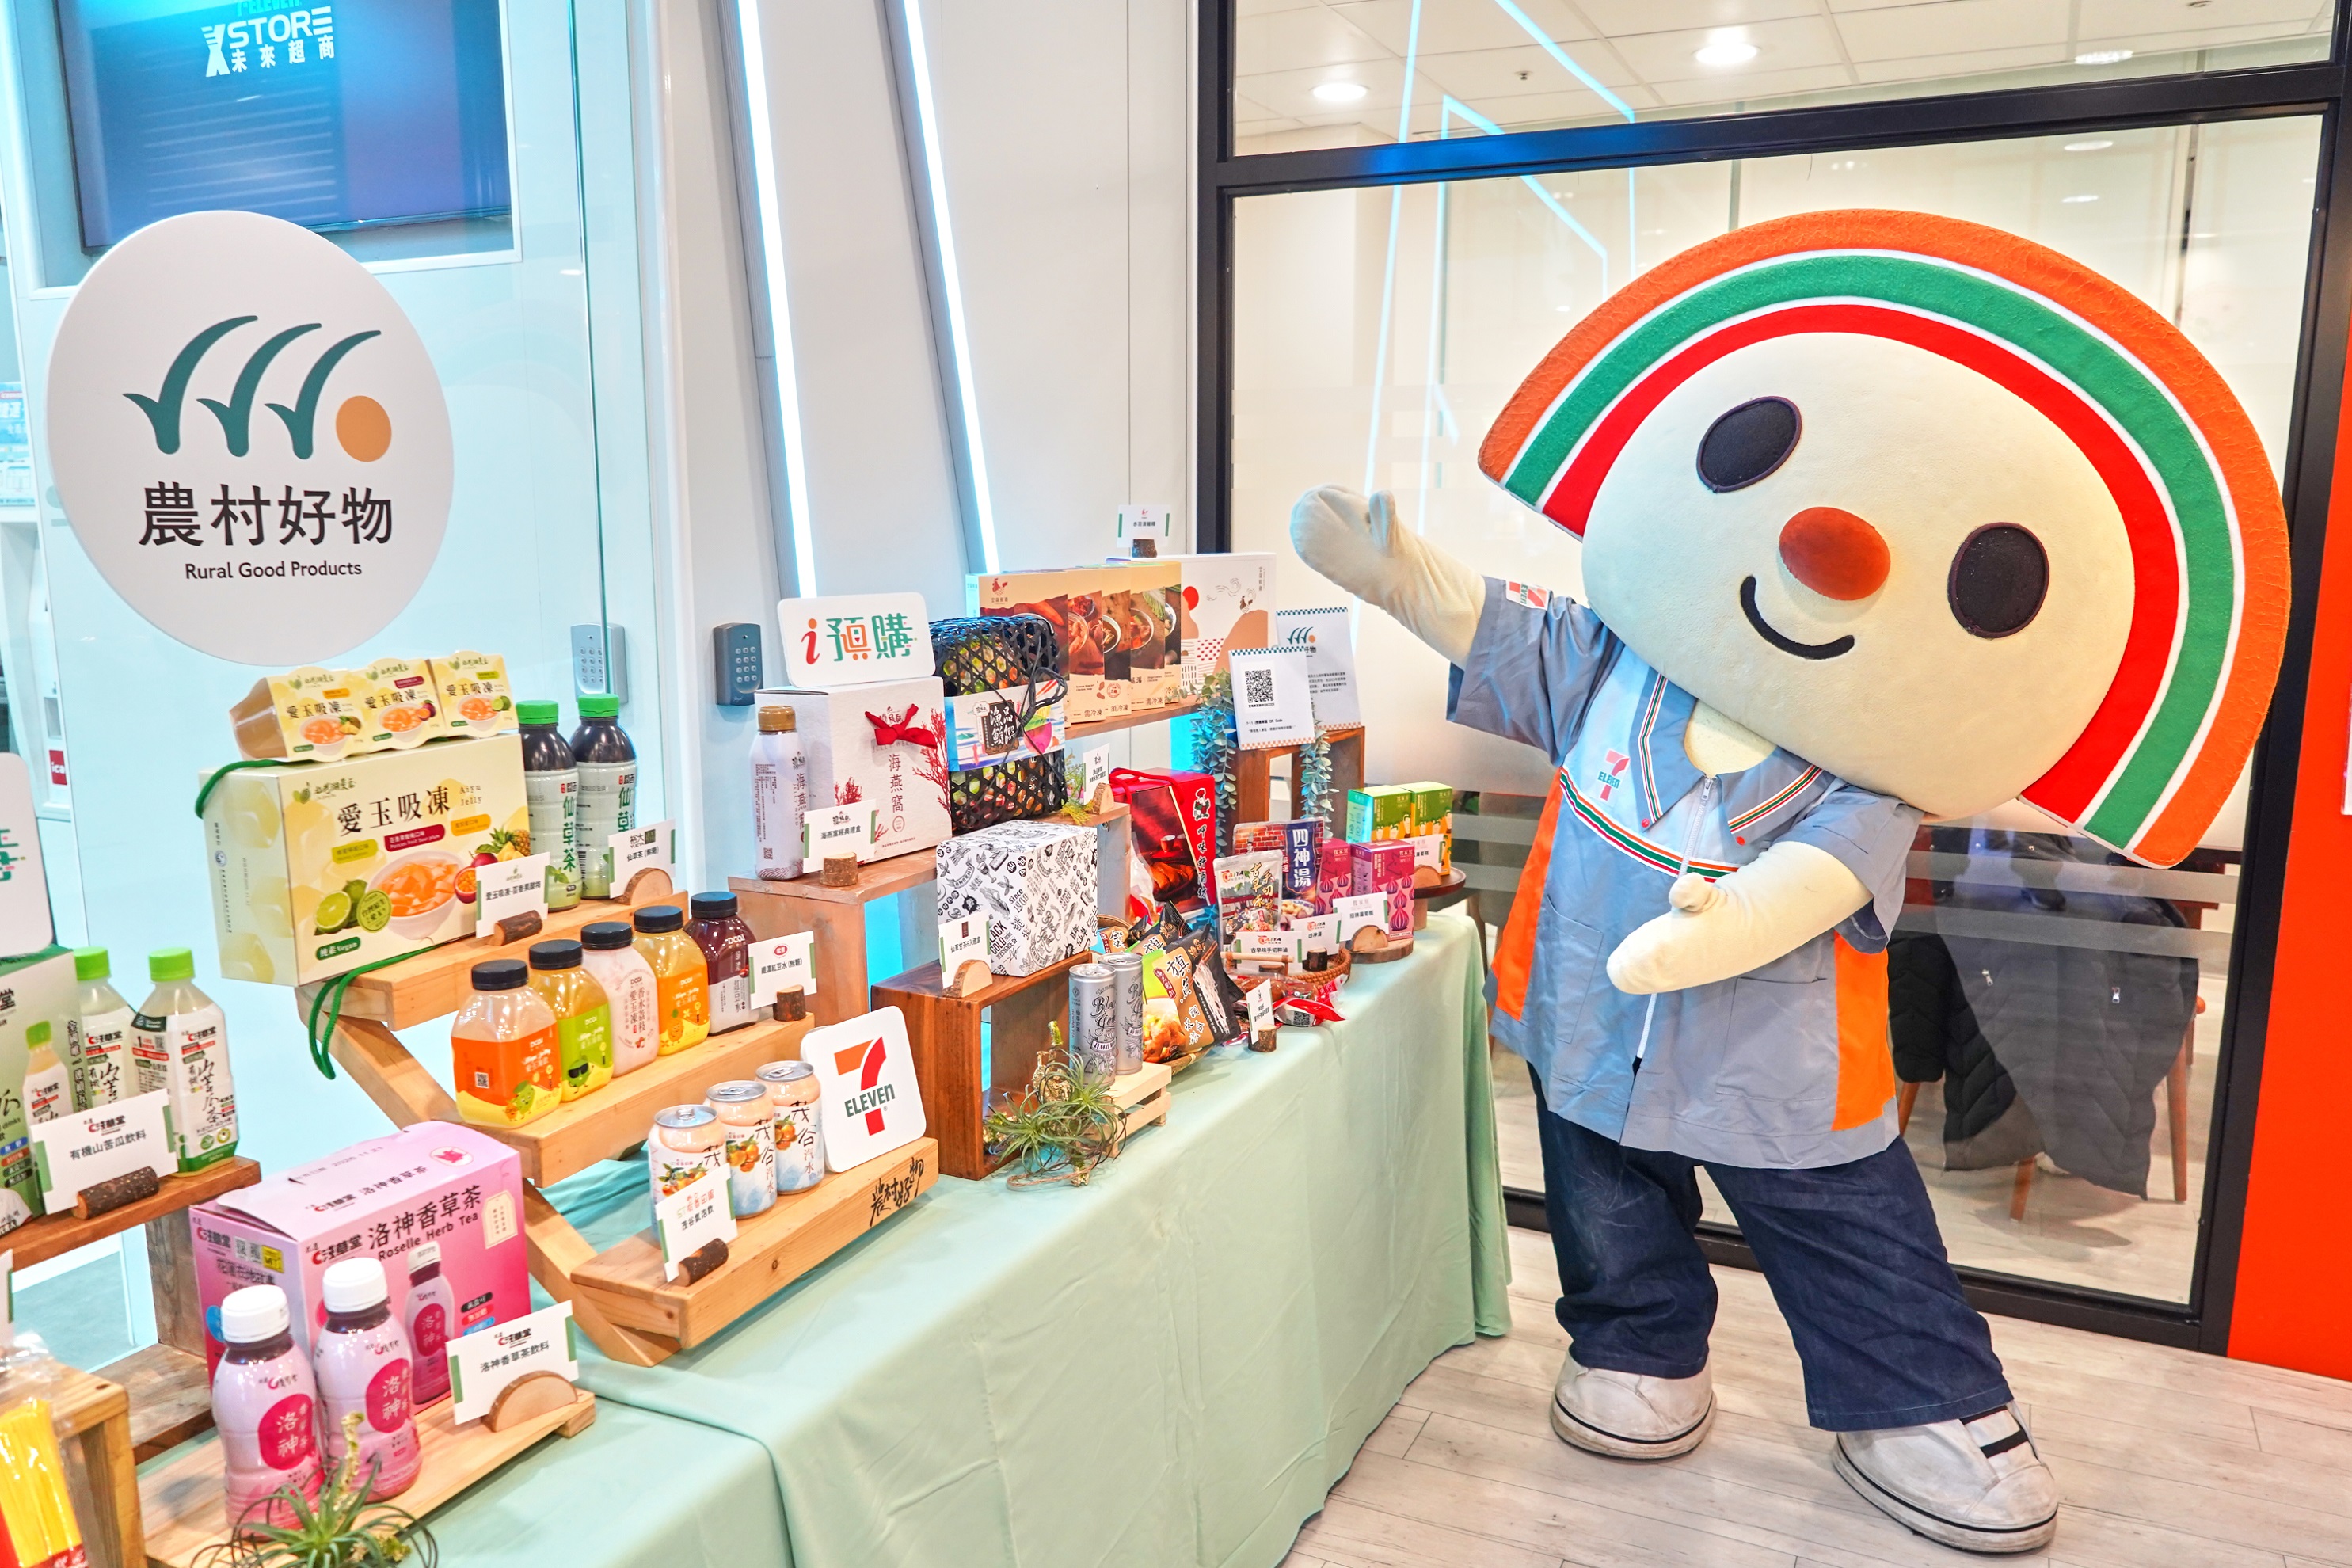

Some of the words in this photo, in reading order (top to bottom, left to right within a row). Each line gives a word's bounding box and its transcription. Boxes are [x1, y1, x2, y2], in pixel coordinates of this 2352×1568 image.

[231, 35, 334, 72] 未來超商
[138, 481, 393, 546] 農村好物
[185, 562, 233, 579] Rural
[239, 561, 285, 577] Good
[291, 560, 362, 577] Products
[460, 795, 482, 806] Jelly
[889, 753, 904, 813] 海燕窩
[337, 786, 451, 836] 愛玉吸凍
[1293, 829, 1311, 888] 四神湯
[989, 919, 1007, 945] LACK
[70, 1129, 147, 1160] 有機山苦瓜飲料
[752, 1118, 775, 1166] 茂谷
[790, 1100, 817, 1147] 茂谷
[359, 1166, 429, 1196] 洛神香草茶
[803, 1147, 815, 1174] 汽水
[368, 1185, 482, 1250] 洛神香草茶
[378, 1237, 421, 1261] Roselle
[426, 1223, 454, 1243] Herb
[459, 1212, 479, 1227] Tea
[681, 1205, 714, 1231] 茂谷氣泡飲
[480, 1341, 550, 1372] 洛神香草茶飲料
[382, 1376, 402, 1421] 洛神
[276, 1411, 299, 1459] 洛神
